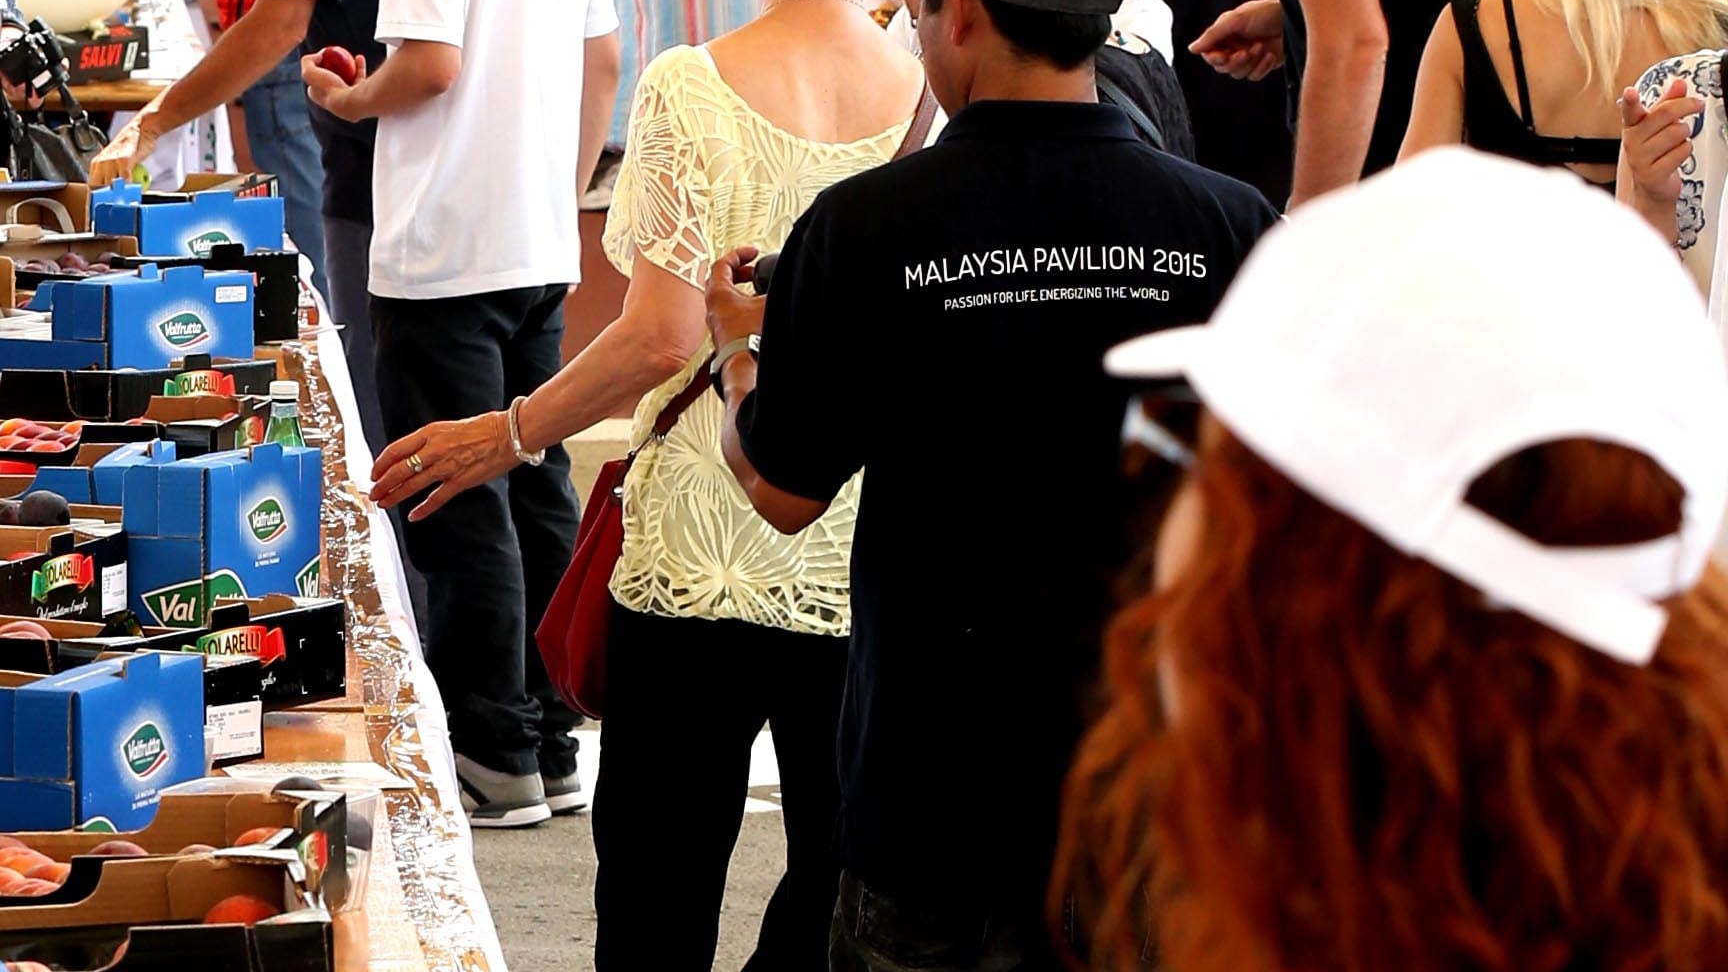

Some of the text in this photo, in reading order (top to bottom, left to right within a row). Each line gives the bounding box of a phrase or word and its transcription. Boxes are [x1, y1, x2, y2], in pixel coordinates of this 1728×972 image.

[79, 42, 123, 70] SALVI
[905, 245, 1207, 290] MALAYSIA PAVILION 2015
[944, 292, 992, 311] PASSION
[993, 290, 1014, 305] FOR
[1039, 286, 1103, 302] ENERGIZING
[1104, 286, 1128, 299] THE
[1129, 287, 1171, 302] WORLD
[164, 321, 202, 336] Valfrutta
[178, 374, 221, 395] SOLARELLI
[251, 510, 281, 531] Valfrutta
[44, 558, 81, 586] SOLARELLI
[128, 737, 161, 762] Valfrutta
